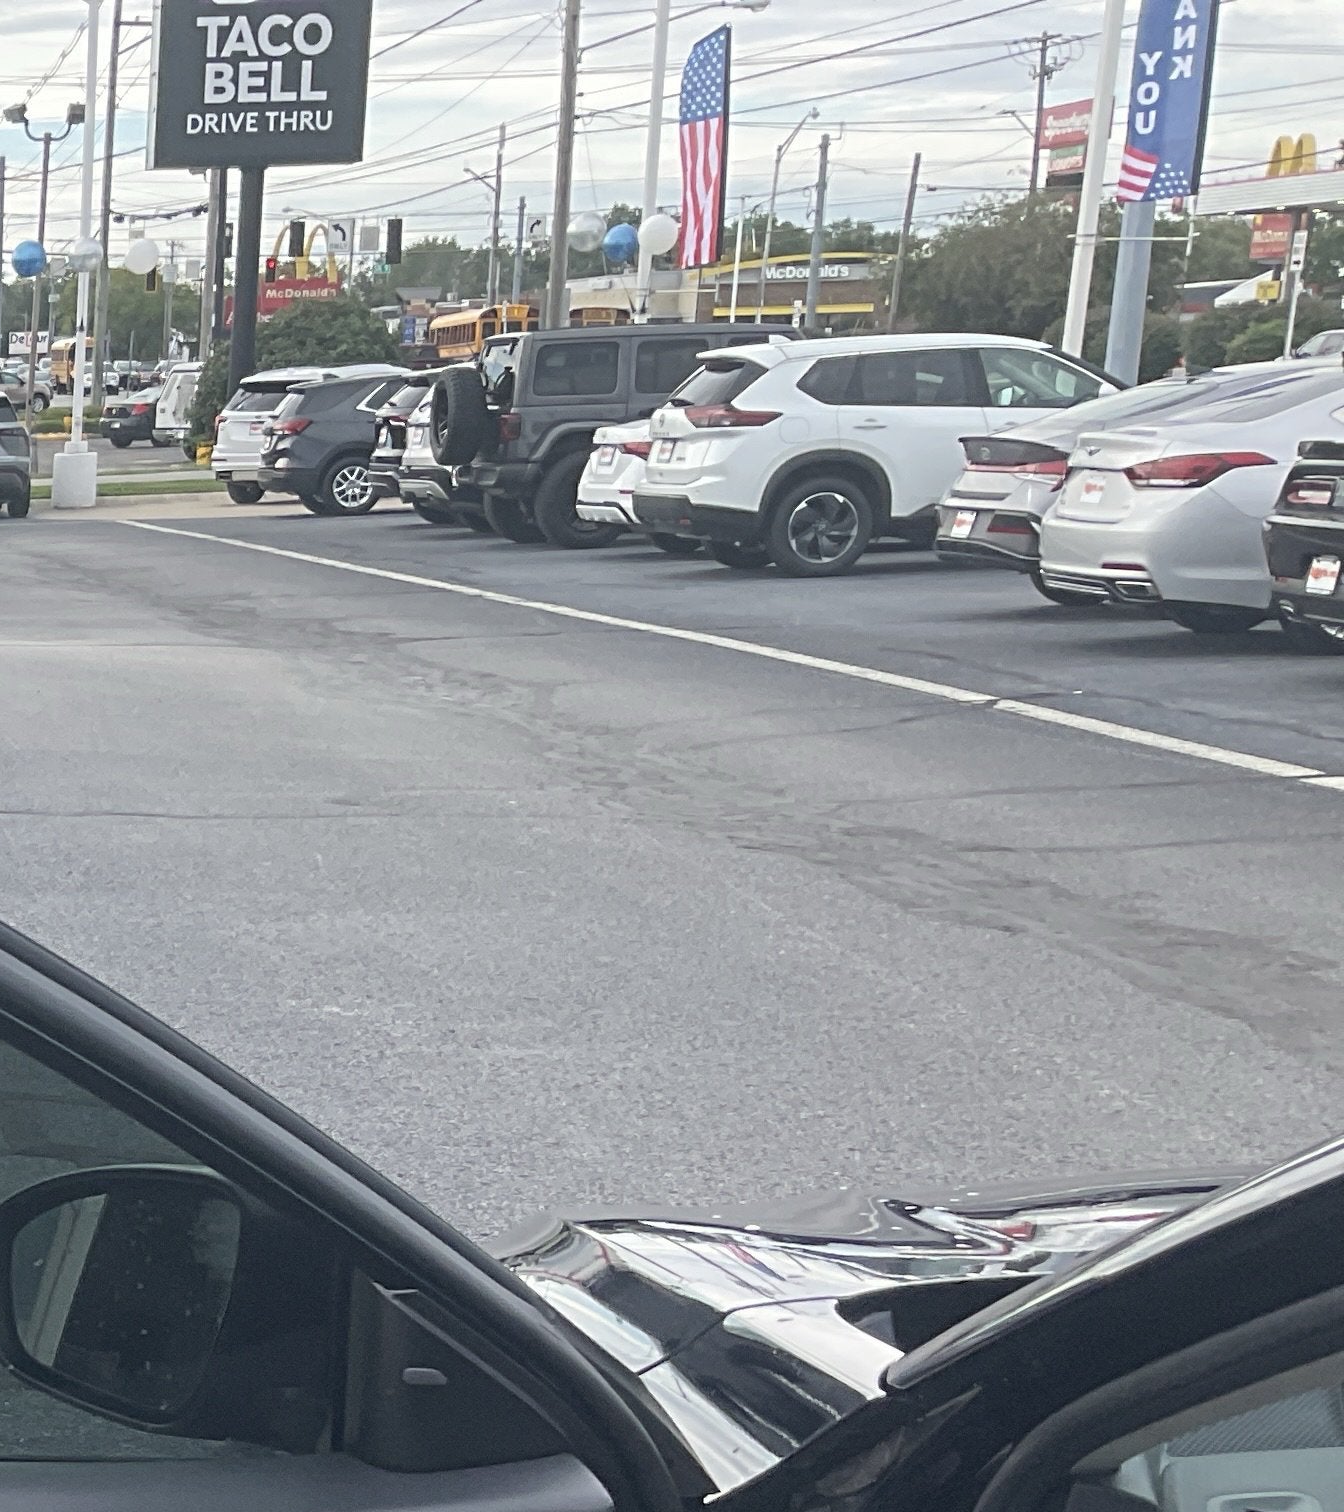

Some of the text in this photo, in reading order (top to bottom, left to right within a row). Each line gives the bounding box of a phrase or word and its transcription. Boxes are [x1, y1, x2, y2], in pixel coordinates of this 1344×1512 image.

[196, 12, 333, 58] TACO
[204, 60, 328, 104] BELL
[186, 110, 333, 135] DRIVE THRU
